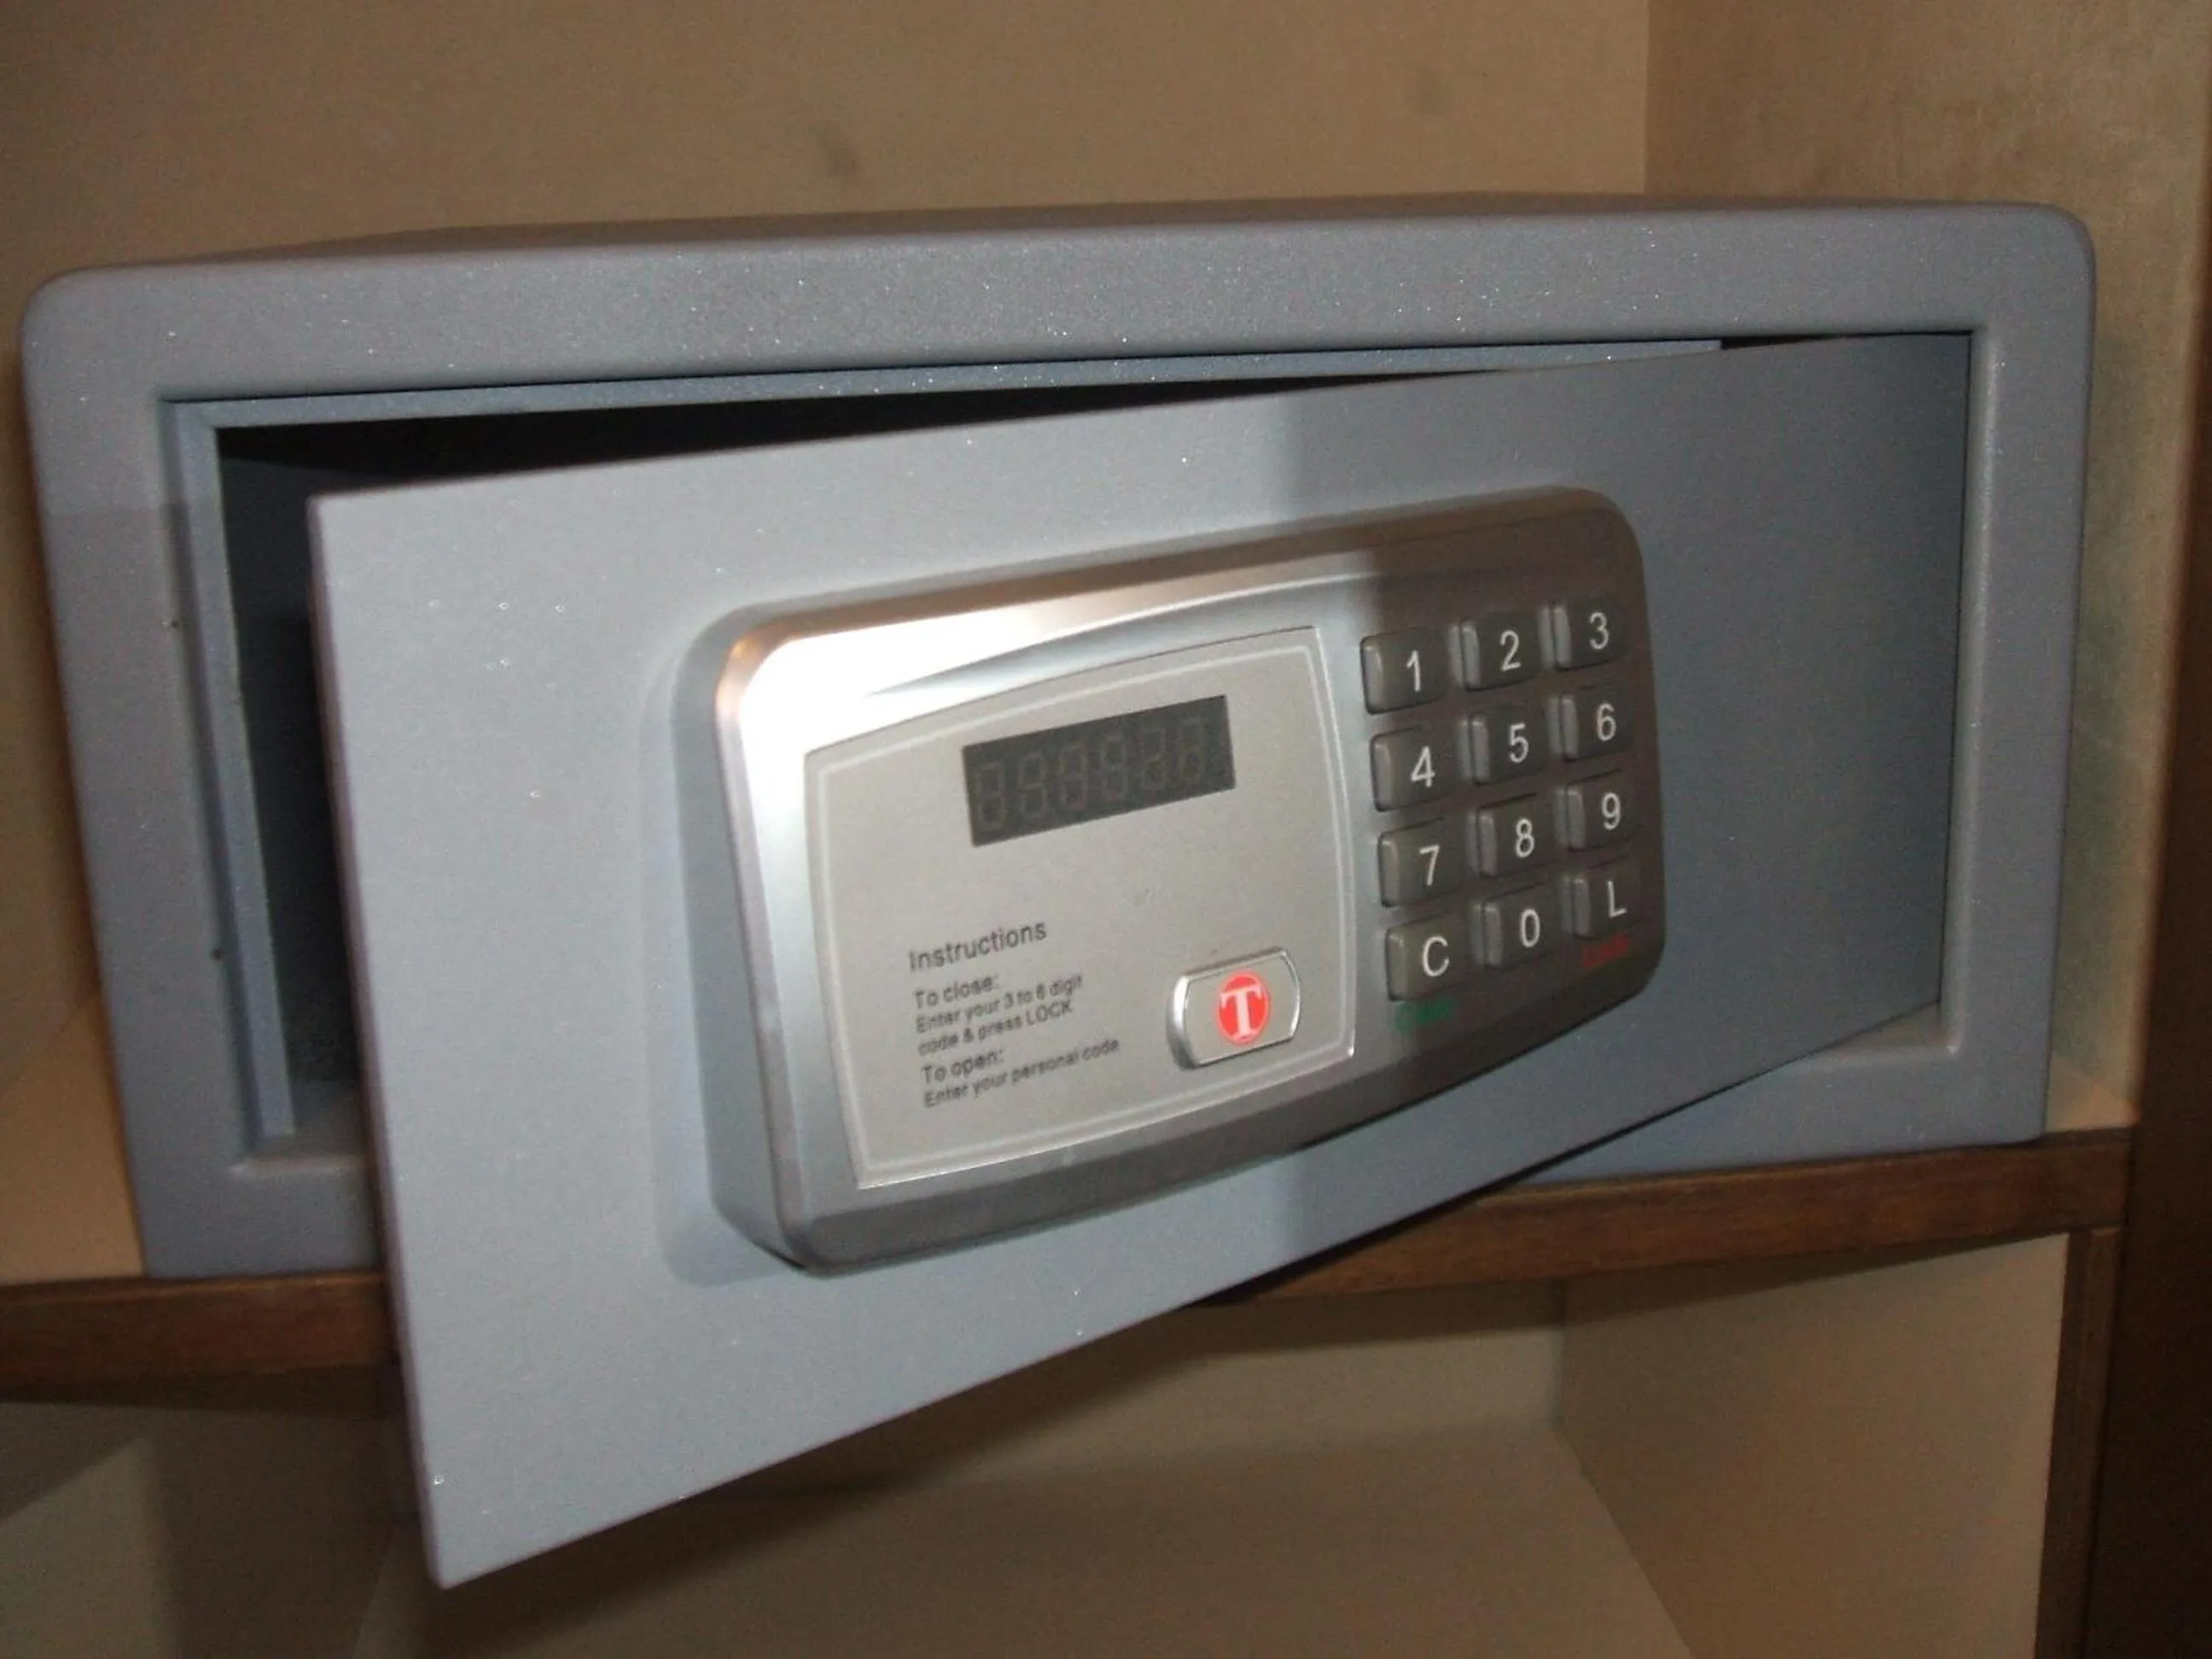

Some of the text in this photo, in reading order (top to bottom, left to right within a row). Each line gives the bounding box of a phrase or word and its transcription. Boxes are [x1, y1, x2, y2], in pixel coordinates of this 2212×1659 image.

[1406, 611, 1610, 692] 1 2 3
[1410, 702, 1617, 788] 4 5 6
[1418, 792, 1621, 887] 7 8 9
[909, 922, 1048, 972] Instructions
[1422, 880, 1627, 977] C 0 L
[915, 975, 999, 1010] To close:
[916, 1009, 961, 1034] Enter
[965, 998, 1000, 1025] your
[1003, 992, 1015, 1010] 3
[1016, 989, 1034, 1005] to
[1220, 981, 1263, 1039] T
[917, 1033, 959, 1057] code
[978, 1015, 1023, 1042] press
[1026, 999, 1074, 1027] LOCK
[922, 1048, 1004, 1084] To open:
[924, 1038, 1121, 1109] Enter your personal code
